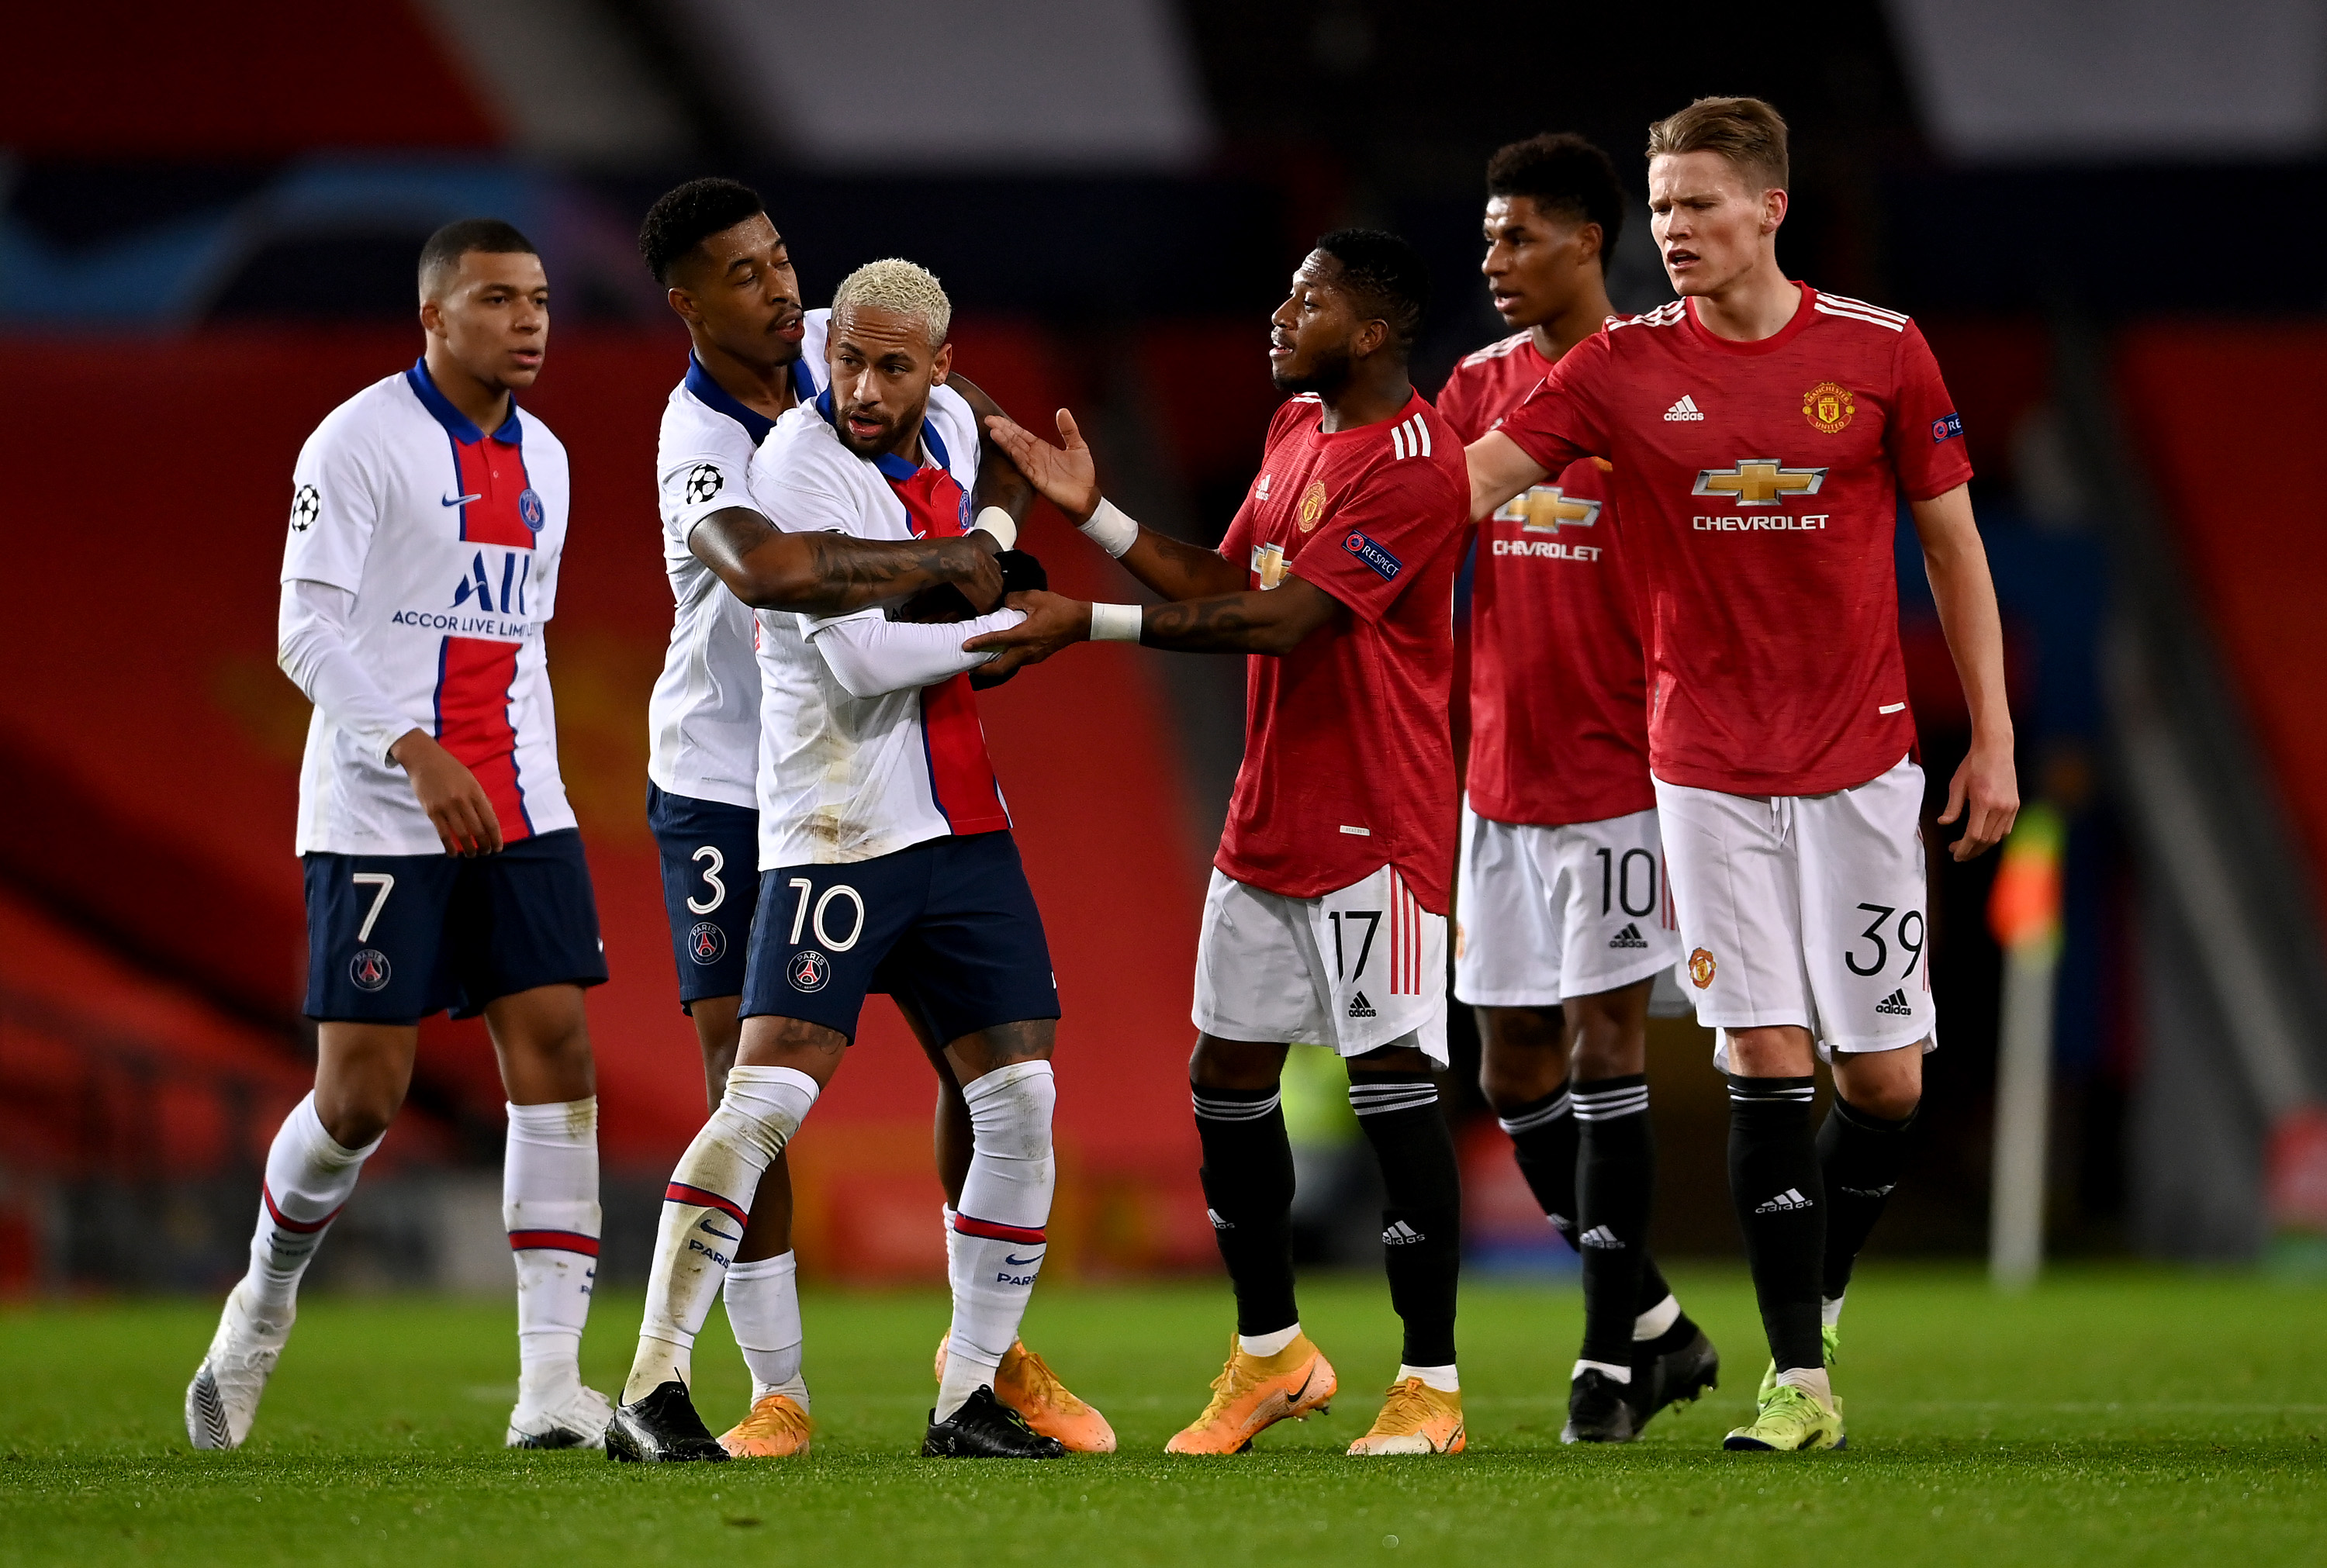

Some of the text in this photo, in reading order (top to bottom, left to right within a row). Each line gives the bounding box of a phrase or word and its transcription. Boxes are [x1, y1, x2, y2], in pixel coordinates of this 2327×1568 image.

[1807, 385, 1850, 403] MANCHESTER
[1663, 410, 1704, 421] adidas
[1815, 421, 1845, 430] UNITED
[1693, 514, 1830, 531] CHEVROLET
[1492, 540, 1603, 562] CHEVROLET
[1361, 545, 1399, 576] RESPECT
[392, 609, 458, 631] ACCOR
[462, 617, 496, 634] LIVE
[686, 845, 725, 915] 3
[1596, 847, 1657, 917] 10
[352, 872, 395, 944] 7
[789, 877, 865, 952] 10
[692, 924, 717, 937] PARIS
[1328, 910, 1383, 984] 17
[1610, 938, 1648, 948] adidas
[1845, 902, 1924, 981] 39
[797, 952, 825, 966] PARIS
[1348, 1007, 1377, 1017] adidas
[1876, 1003, 1912, 1016] adidas
[1755, 1199, 1814, 1214] adidas
[1381, 1232, 1426, 1245] adidas
[688, 1238, 731, 1269] PARIS
